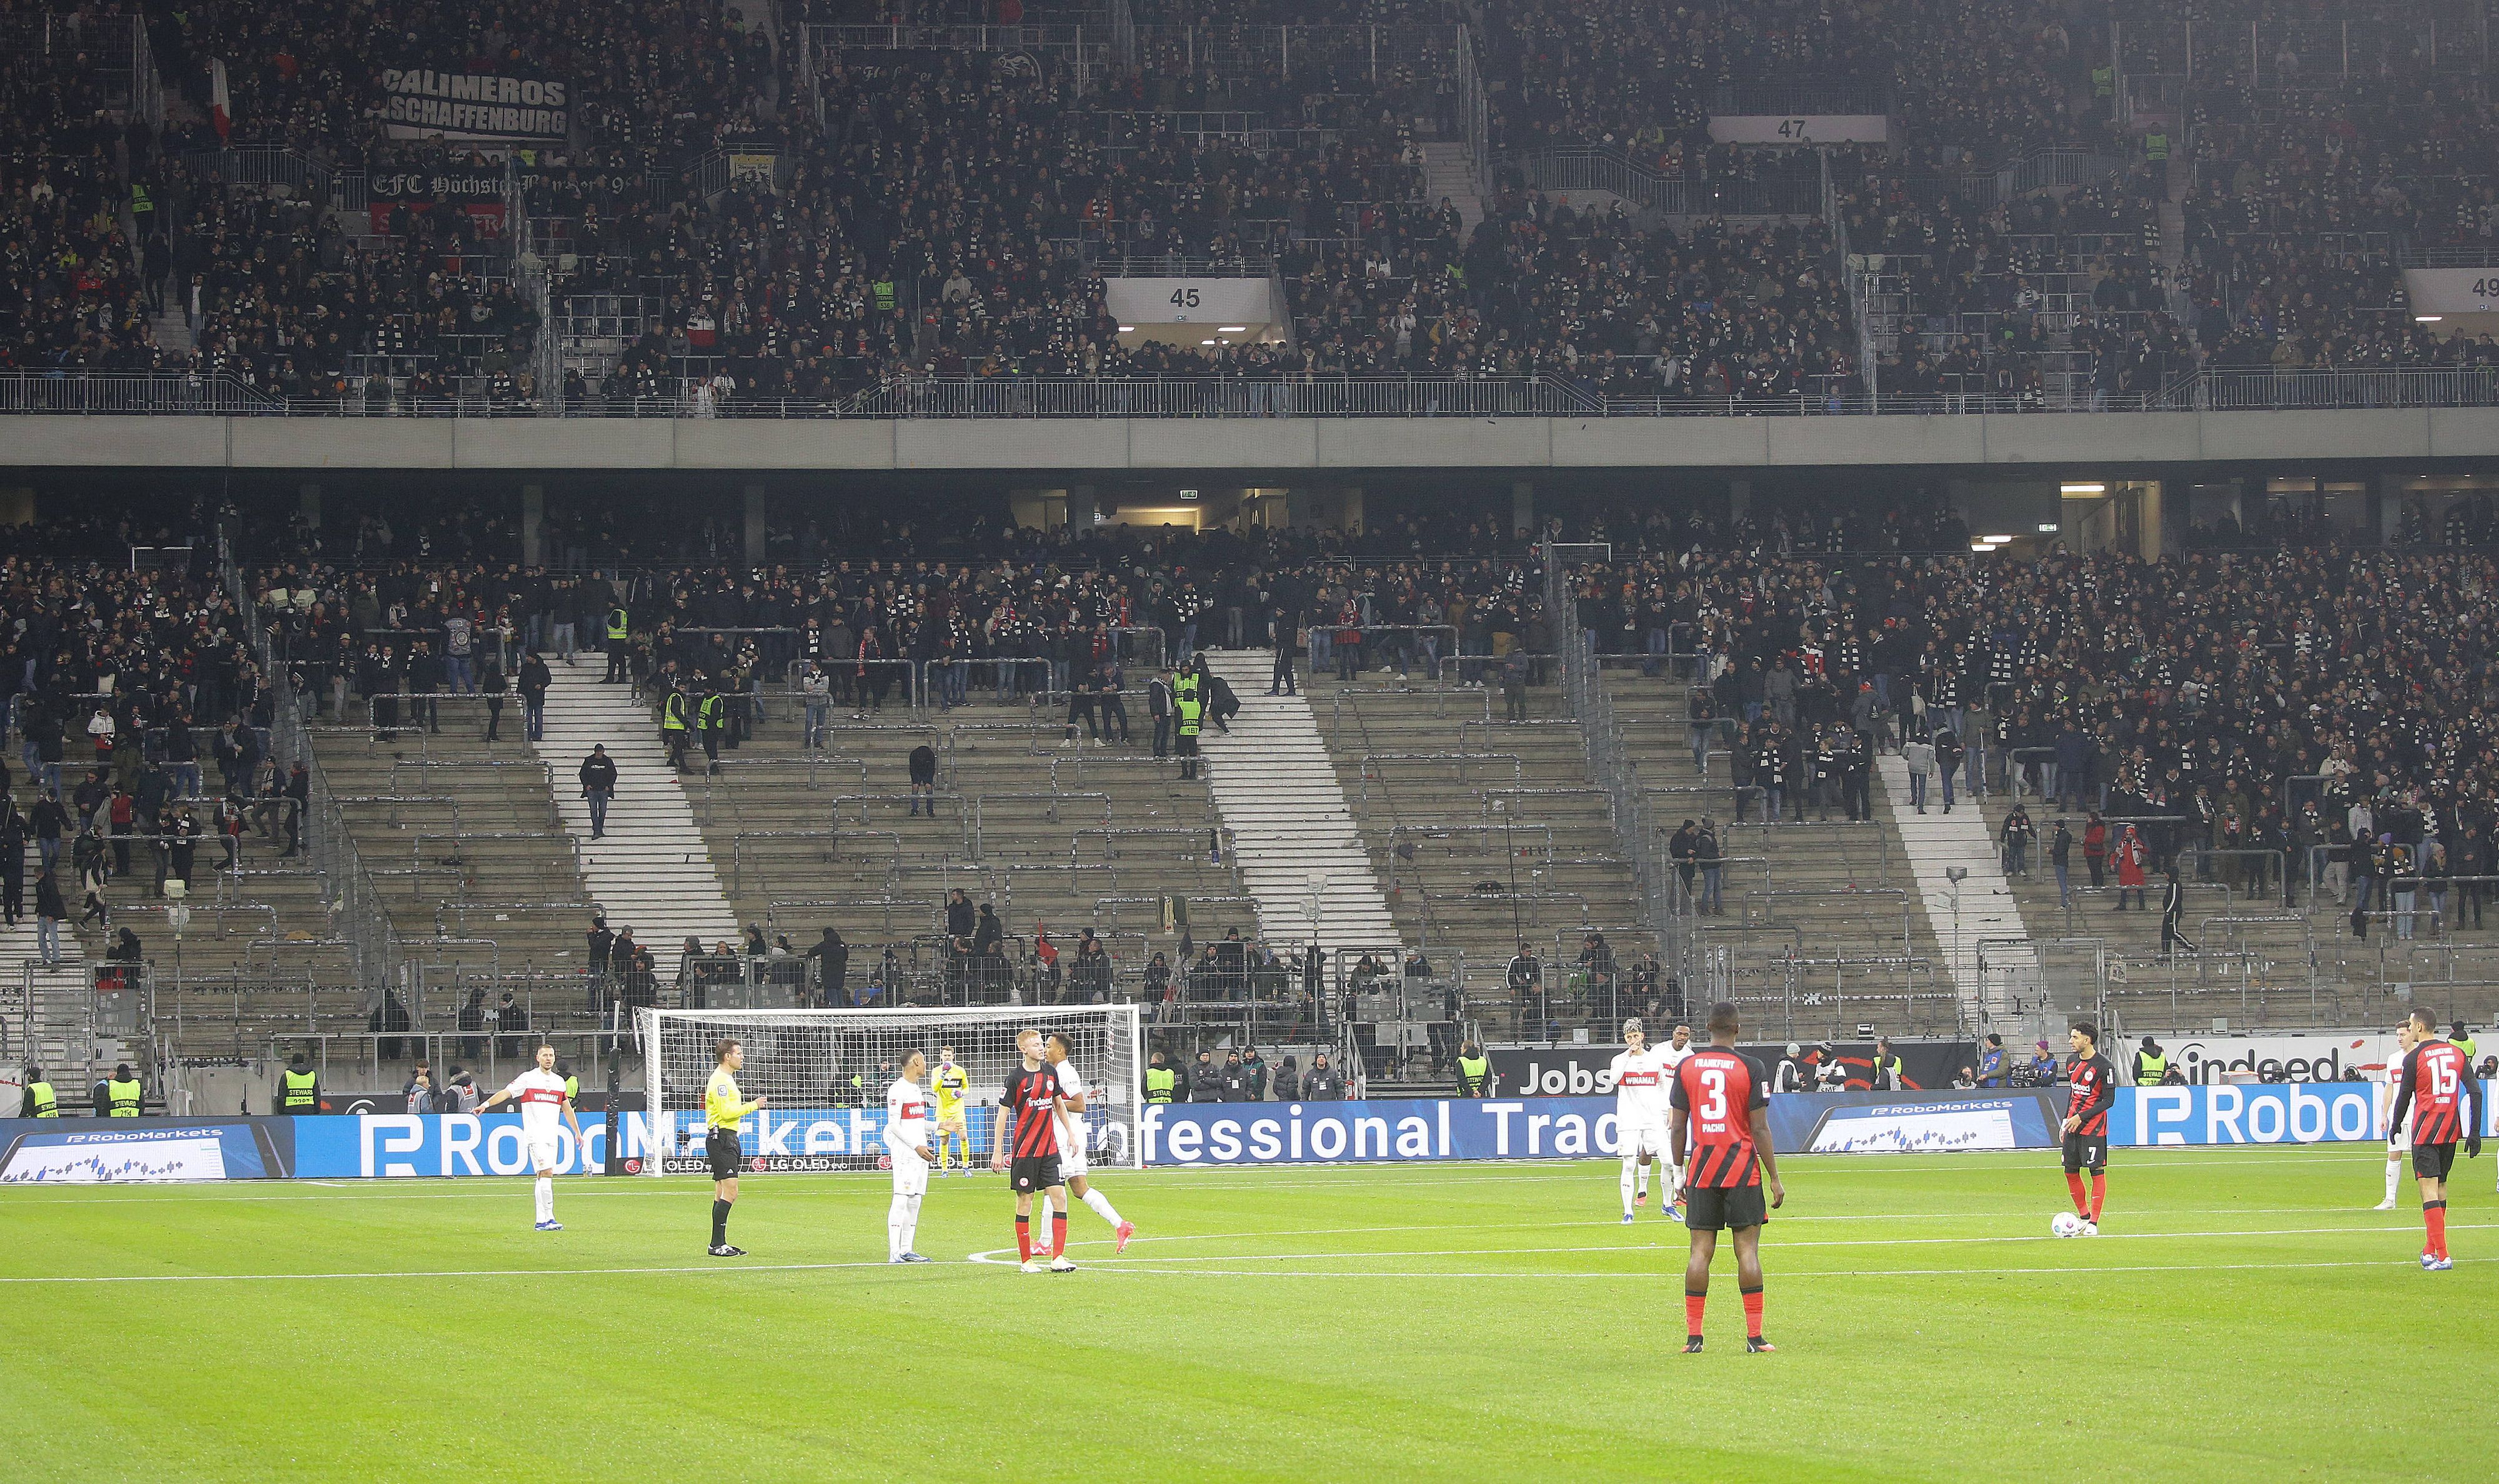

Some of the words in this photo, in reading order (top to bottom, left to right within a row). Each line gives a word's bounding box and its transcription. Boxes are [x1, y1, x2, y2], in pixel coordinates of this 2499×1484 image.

[382, 69, 566, 106] CALIMEROS
[1779, 120, 1806, 139] 47
[2472, 278, 2499, 297] 49
[1170, 288, 1200, 308] 45
[1694, 1058, 1735, 1070] FRANKFURT
[2177, 1043, 2338, 1085] indeed
[1519, 1061, 1614, 1095] Jobs
[1625, 1076, 1655, 1085] WINAMAX
[2427, 1055, 2457, 1096] 15
[1026, 1096, 1053, 1107] indeed
[1700, 1069, 1727, 1120] 3
[1890, 1101, 2014, 1114] RoboMarkets
[1702, 1123, 1726, 1133] PACHO
[87, 1129, 223, 1142] RoboMarkets
[2088, 1146, 2097, 1160] 7
[666, 1160, 704, 1171] OLED
[769, 1159, 788, 1170] LG
[792, 1158, 830, 1170] OLED
[831, 1162, 848, 1170] evo
